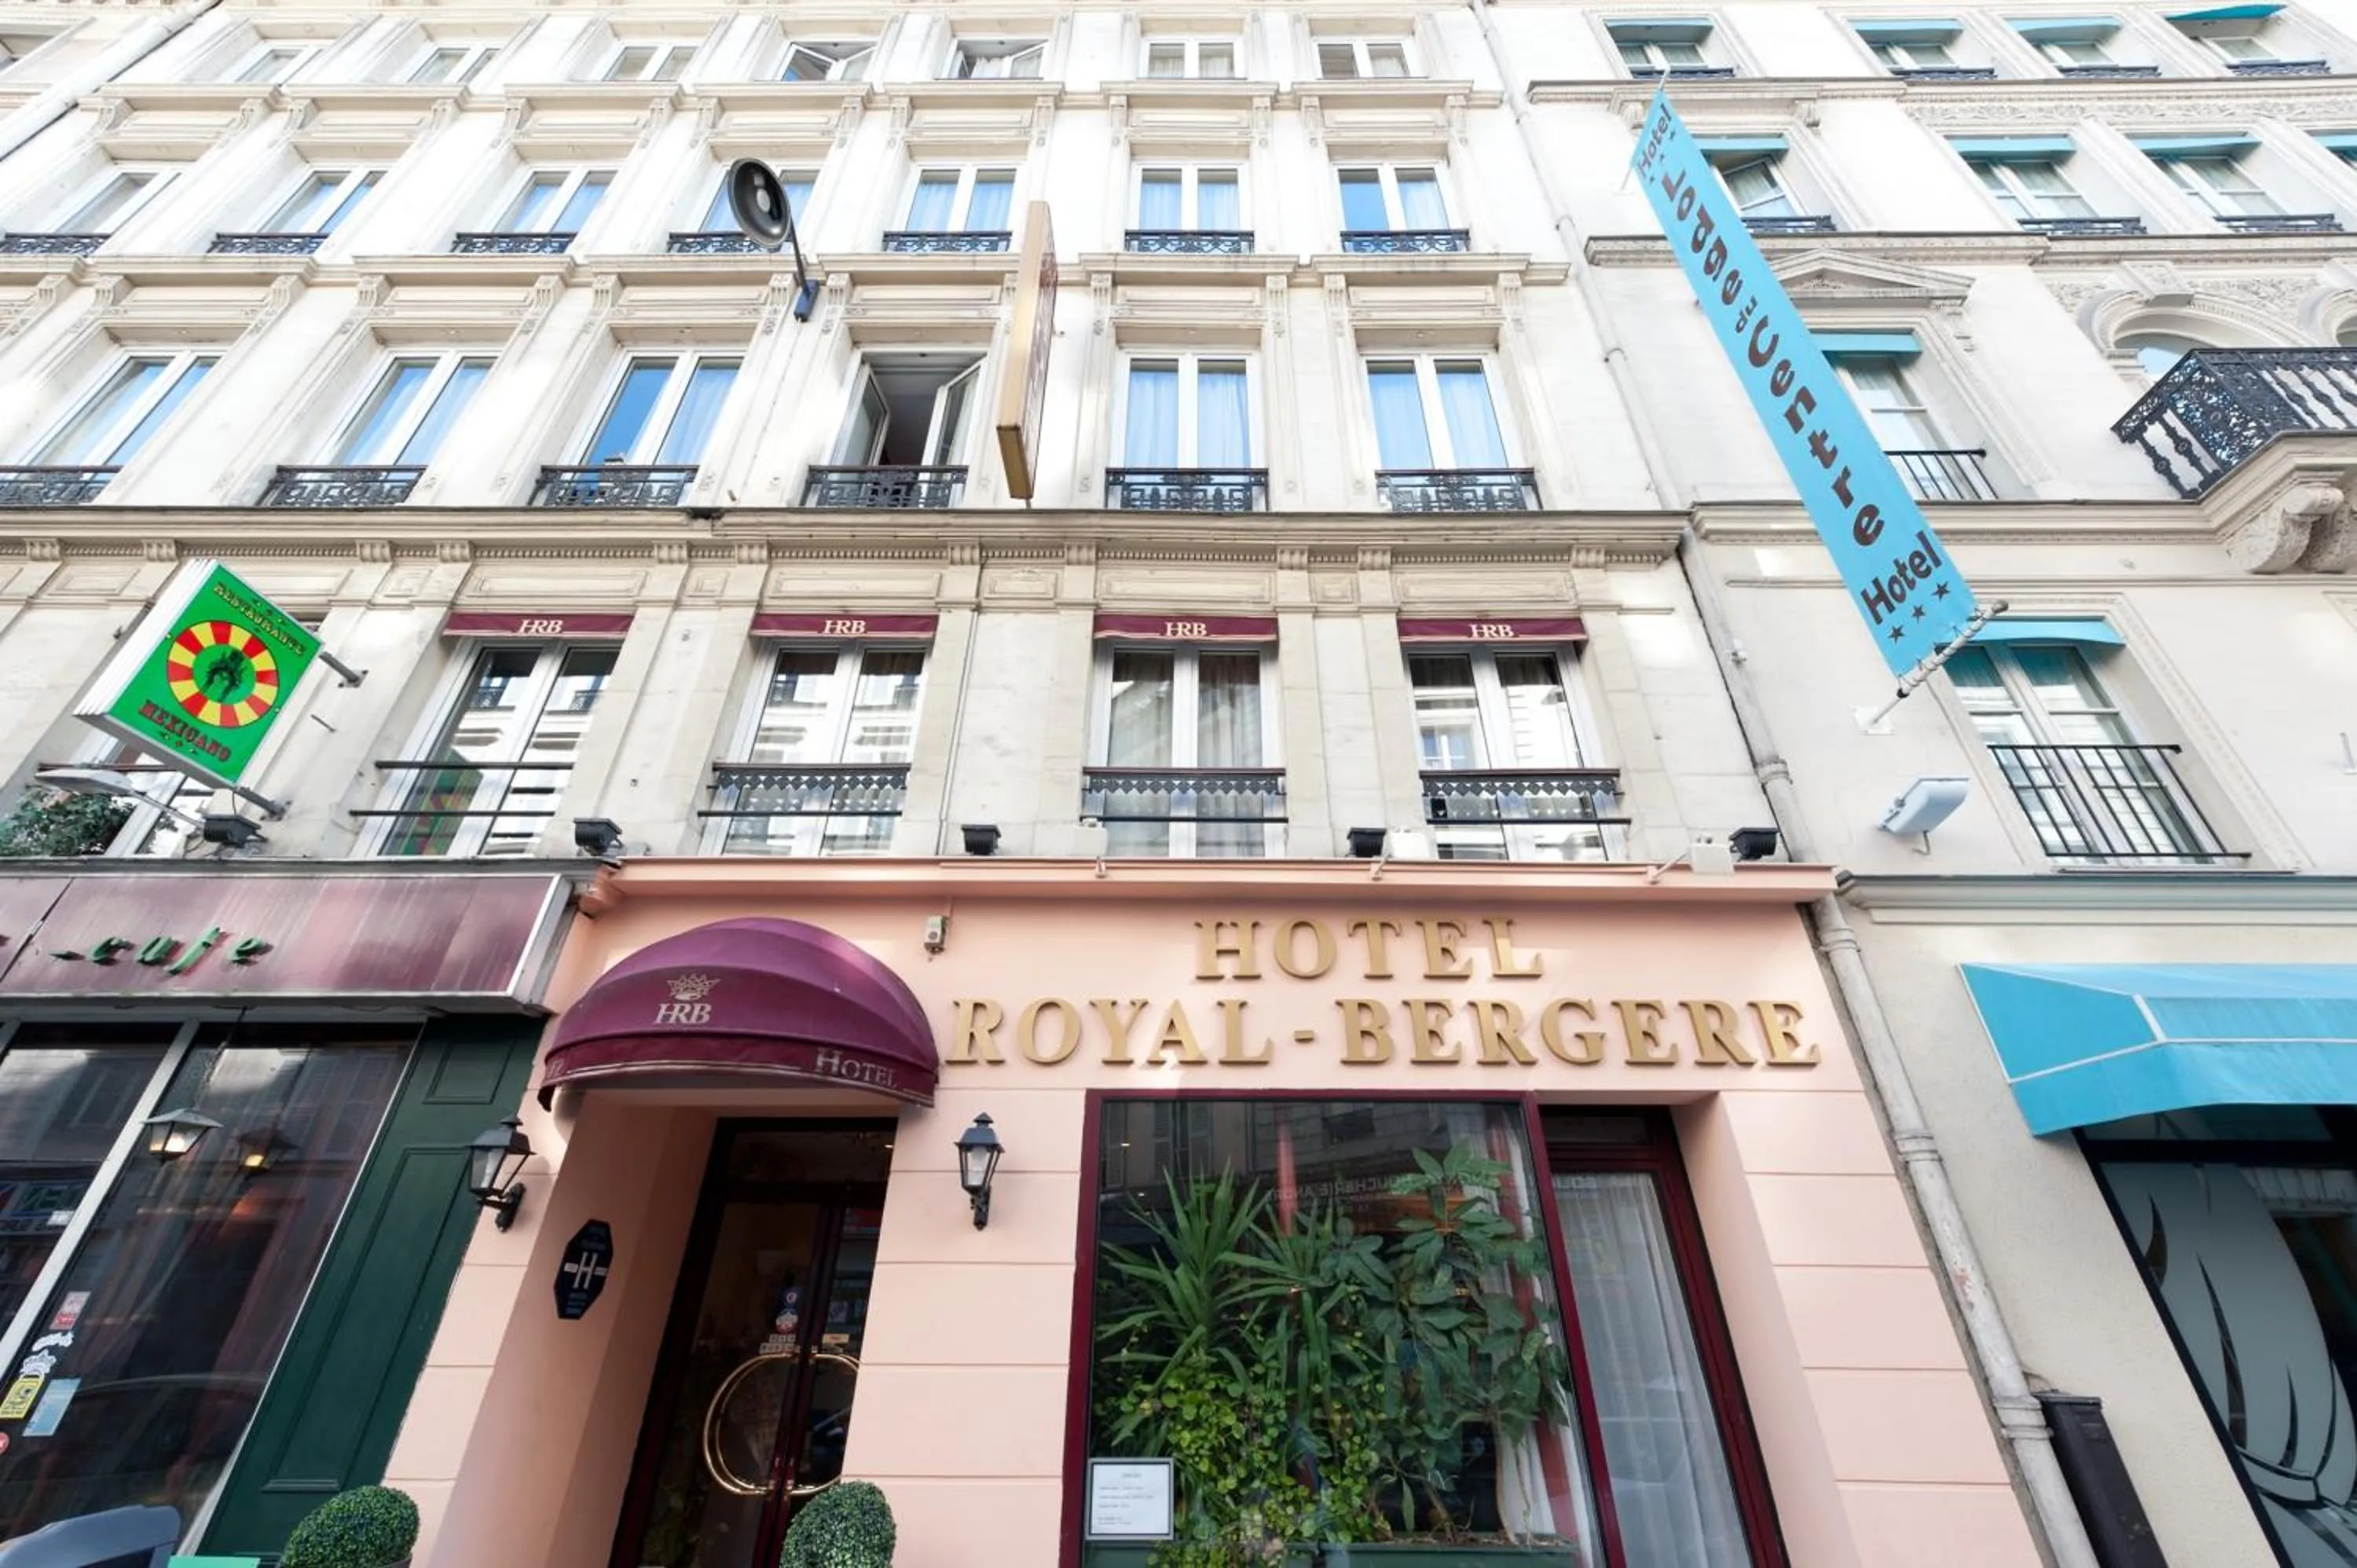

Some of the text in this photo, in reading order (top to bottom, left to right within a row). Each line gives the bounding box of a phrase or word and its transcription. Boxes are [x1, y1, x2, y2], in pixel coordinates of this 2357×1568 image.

[1637, 103, 1673, 180] Hotel
[1662, 169, 1885, 546] Lodge du Centre
[1860, 529, 1942, 625] Hotel
[518, 619, 563, 634] HRB
[823, 619, 866, 634] HRB
[1164, 621, 1208, 636] HRB
[1469, 623, 1514, 639] HRB
[137, 698, 233, 763] MEXICANO
[1195, 918, 1544, 980] HOTEL
[653, 1002, 712, 1024] HRB
[572, 1251, 599, 1290] H
